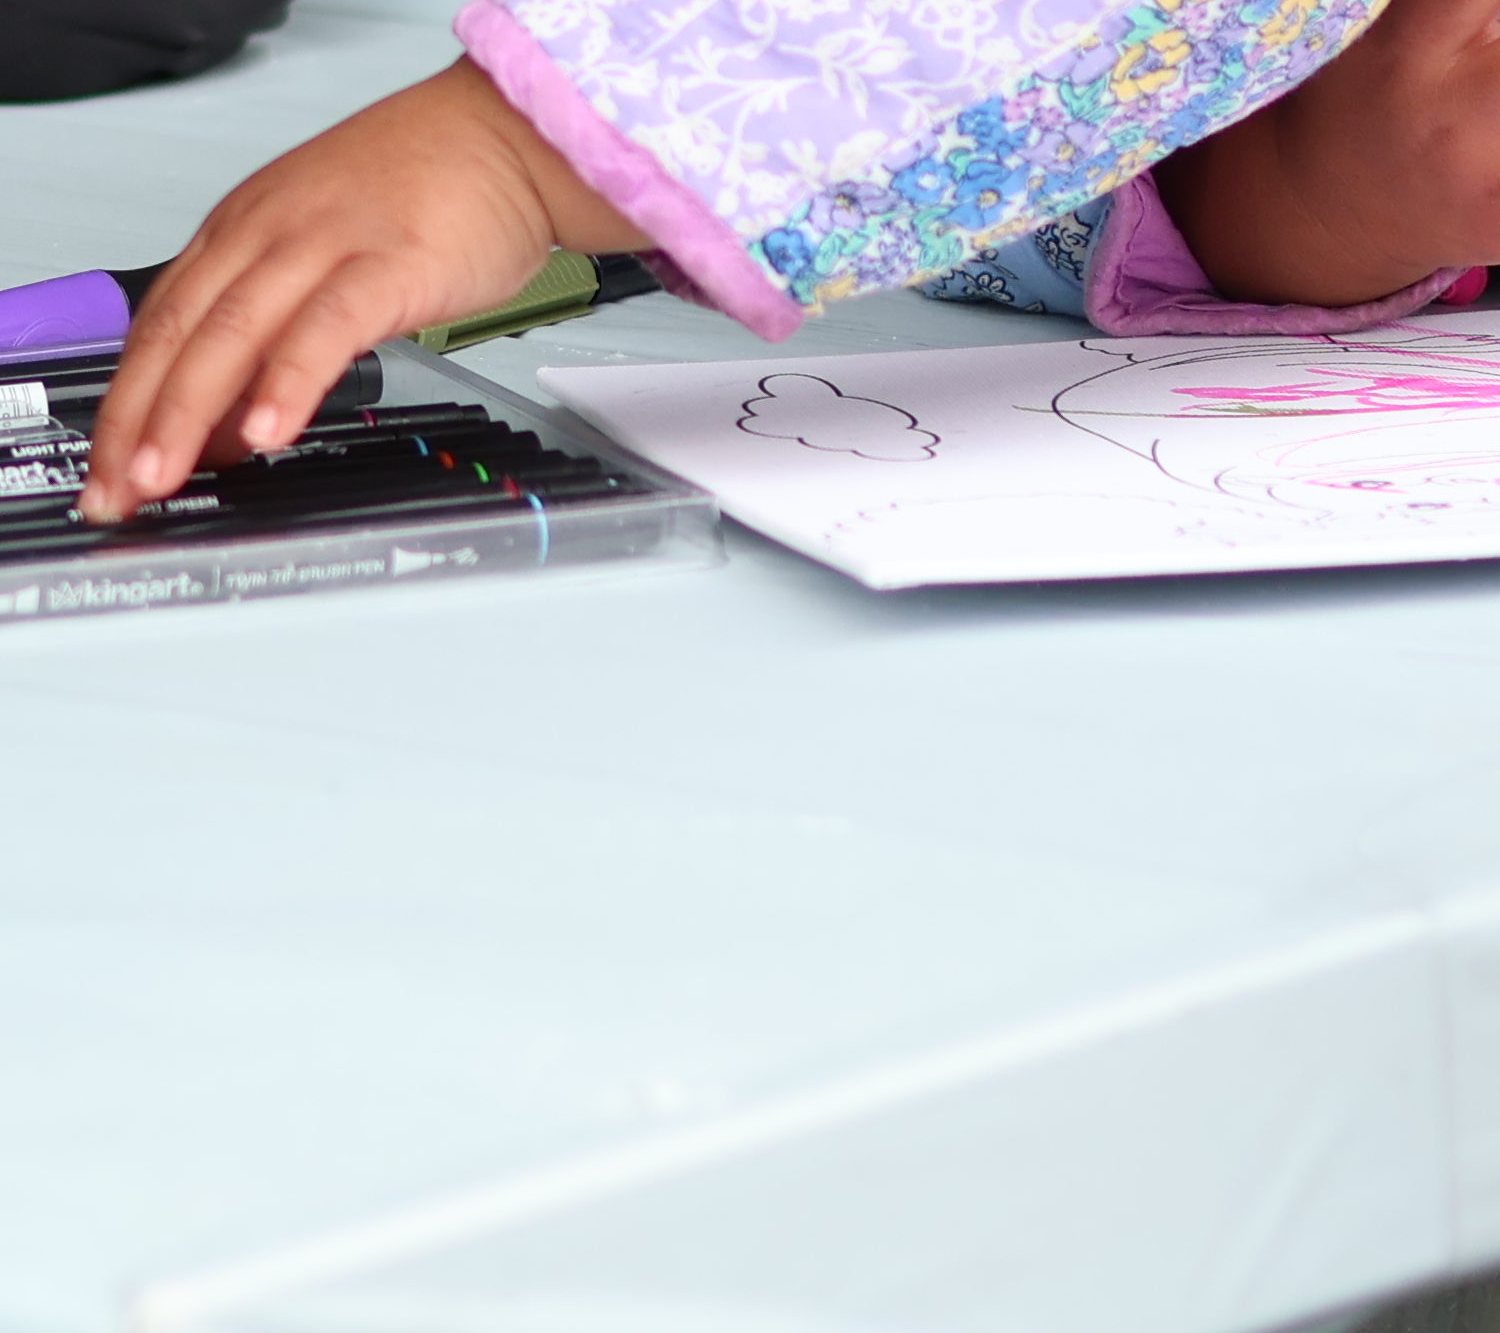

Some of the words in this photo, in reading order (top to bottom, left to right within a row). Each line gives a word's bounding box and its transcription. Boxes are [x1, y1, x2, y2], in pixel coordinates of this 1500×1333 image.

[11, 443, 56, 458] LIGHT
[59, 440, 93, 453] PUR
[85, 572, 192, 603] kingart
[225, 571, 267, 588] TWIN
[355, 559, 385, 575] PEN
